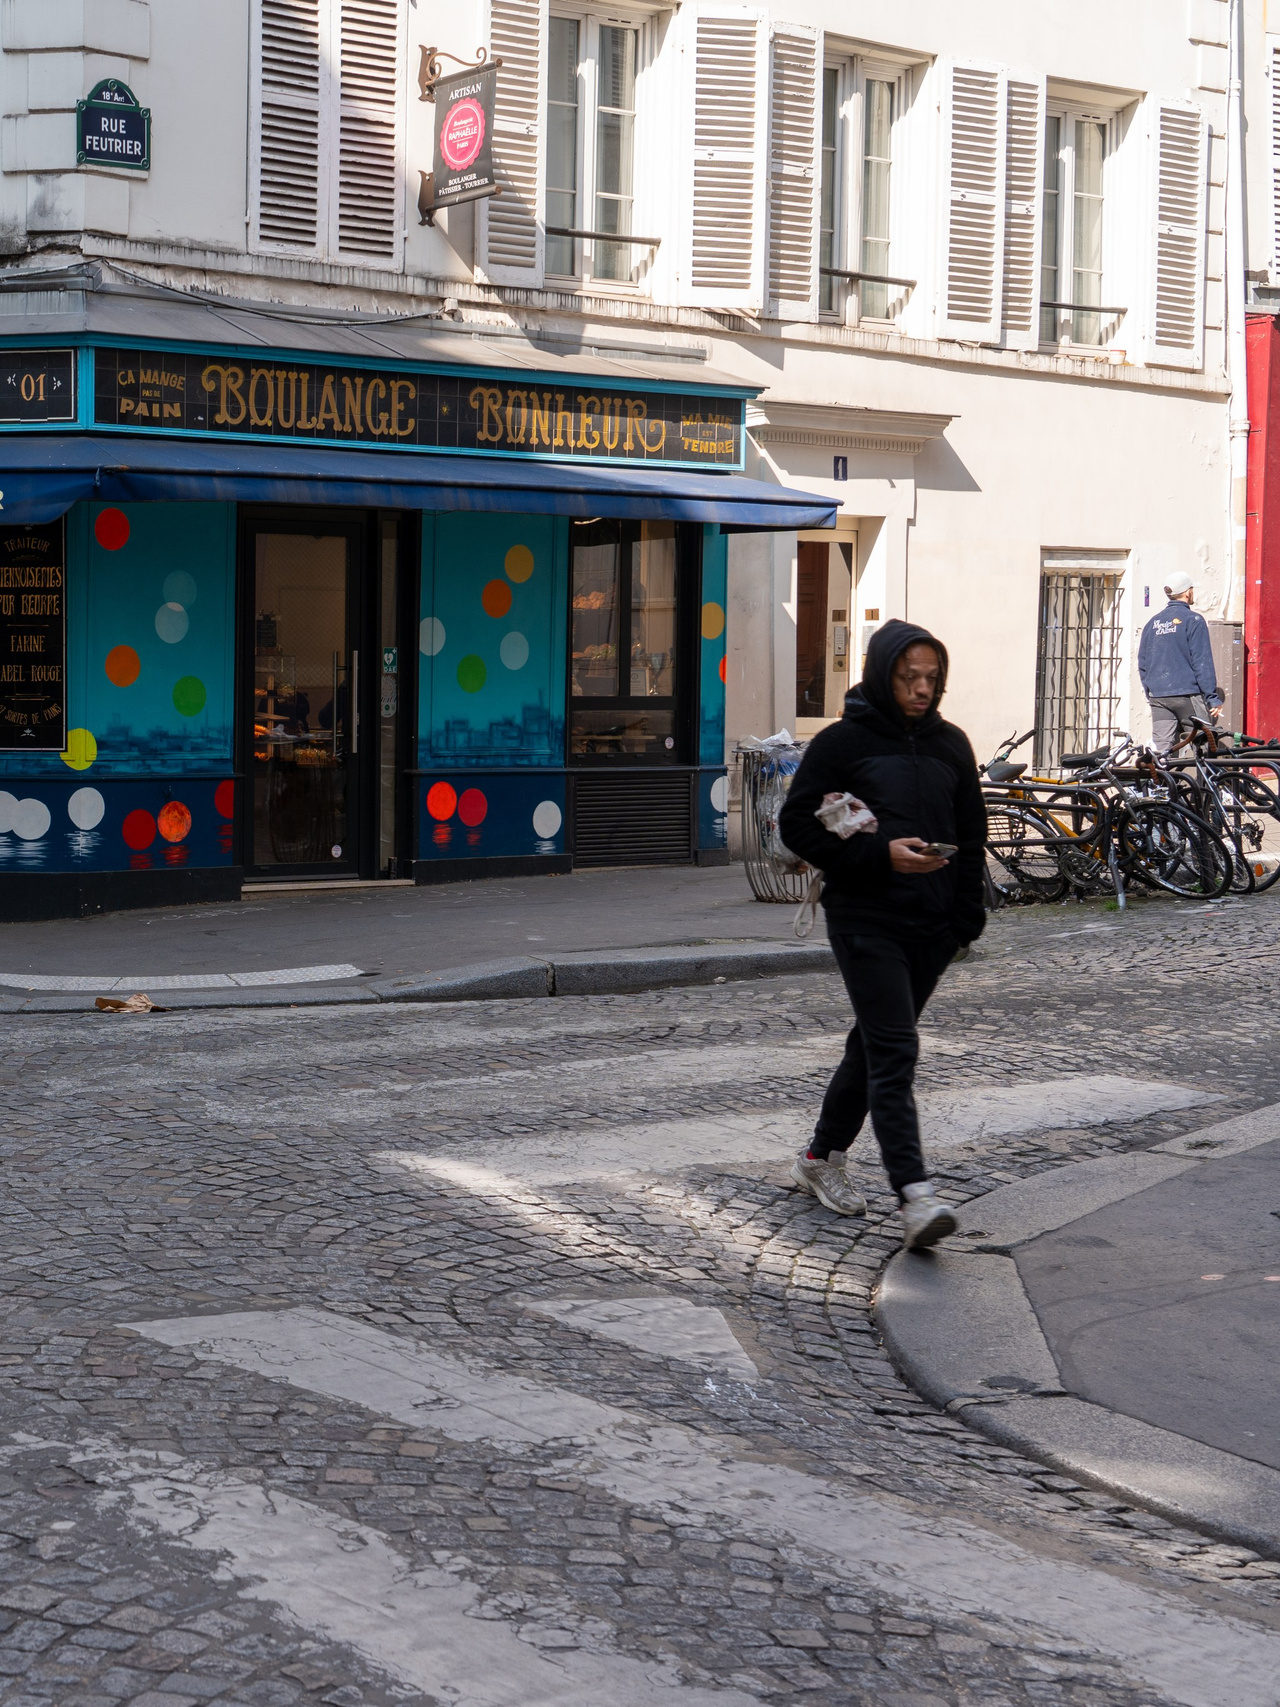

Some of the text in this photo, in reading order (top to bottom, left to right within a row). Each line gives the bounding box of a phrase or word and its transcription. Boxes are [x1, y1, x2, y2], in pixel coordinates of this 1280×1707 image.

[449, 83, 482, 100] ARTISAN
[101, 117, 126, 134] RUE
[448, 125, 478, 141] RAPHAËLLE
[85, 135, 142, 156] FEUTRIER
[448, 173, 477, 186] BOULANGER
[20, 372, 47, 402] 01
[140, 369, 186, 391] MANGE
[154, 390, 161, 398] DE
[201, 364, 417, 437] BOULANGE
[119, 397, 182, 419] PAIN
[682, 412, 733, 430] MA MIE
[681, 436, 735, 454] TENDRE
[837, 458, 844, 480] 1
[3, 537, 51, 553] TRAITEUR
[21, 594, 60, 616] BEURRE
[10, 635, 46, 652] FARINE
[31, 665, 62, 682] ROUGE
[4, 710, 28, 726] SORTES
[32, 712, 41, 725] DE
[44, 702, 62, 722] PAINS
